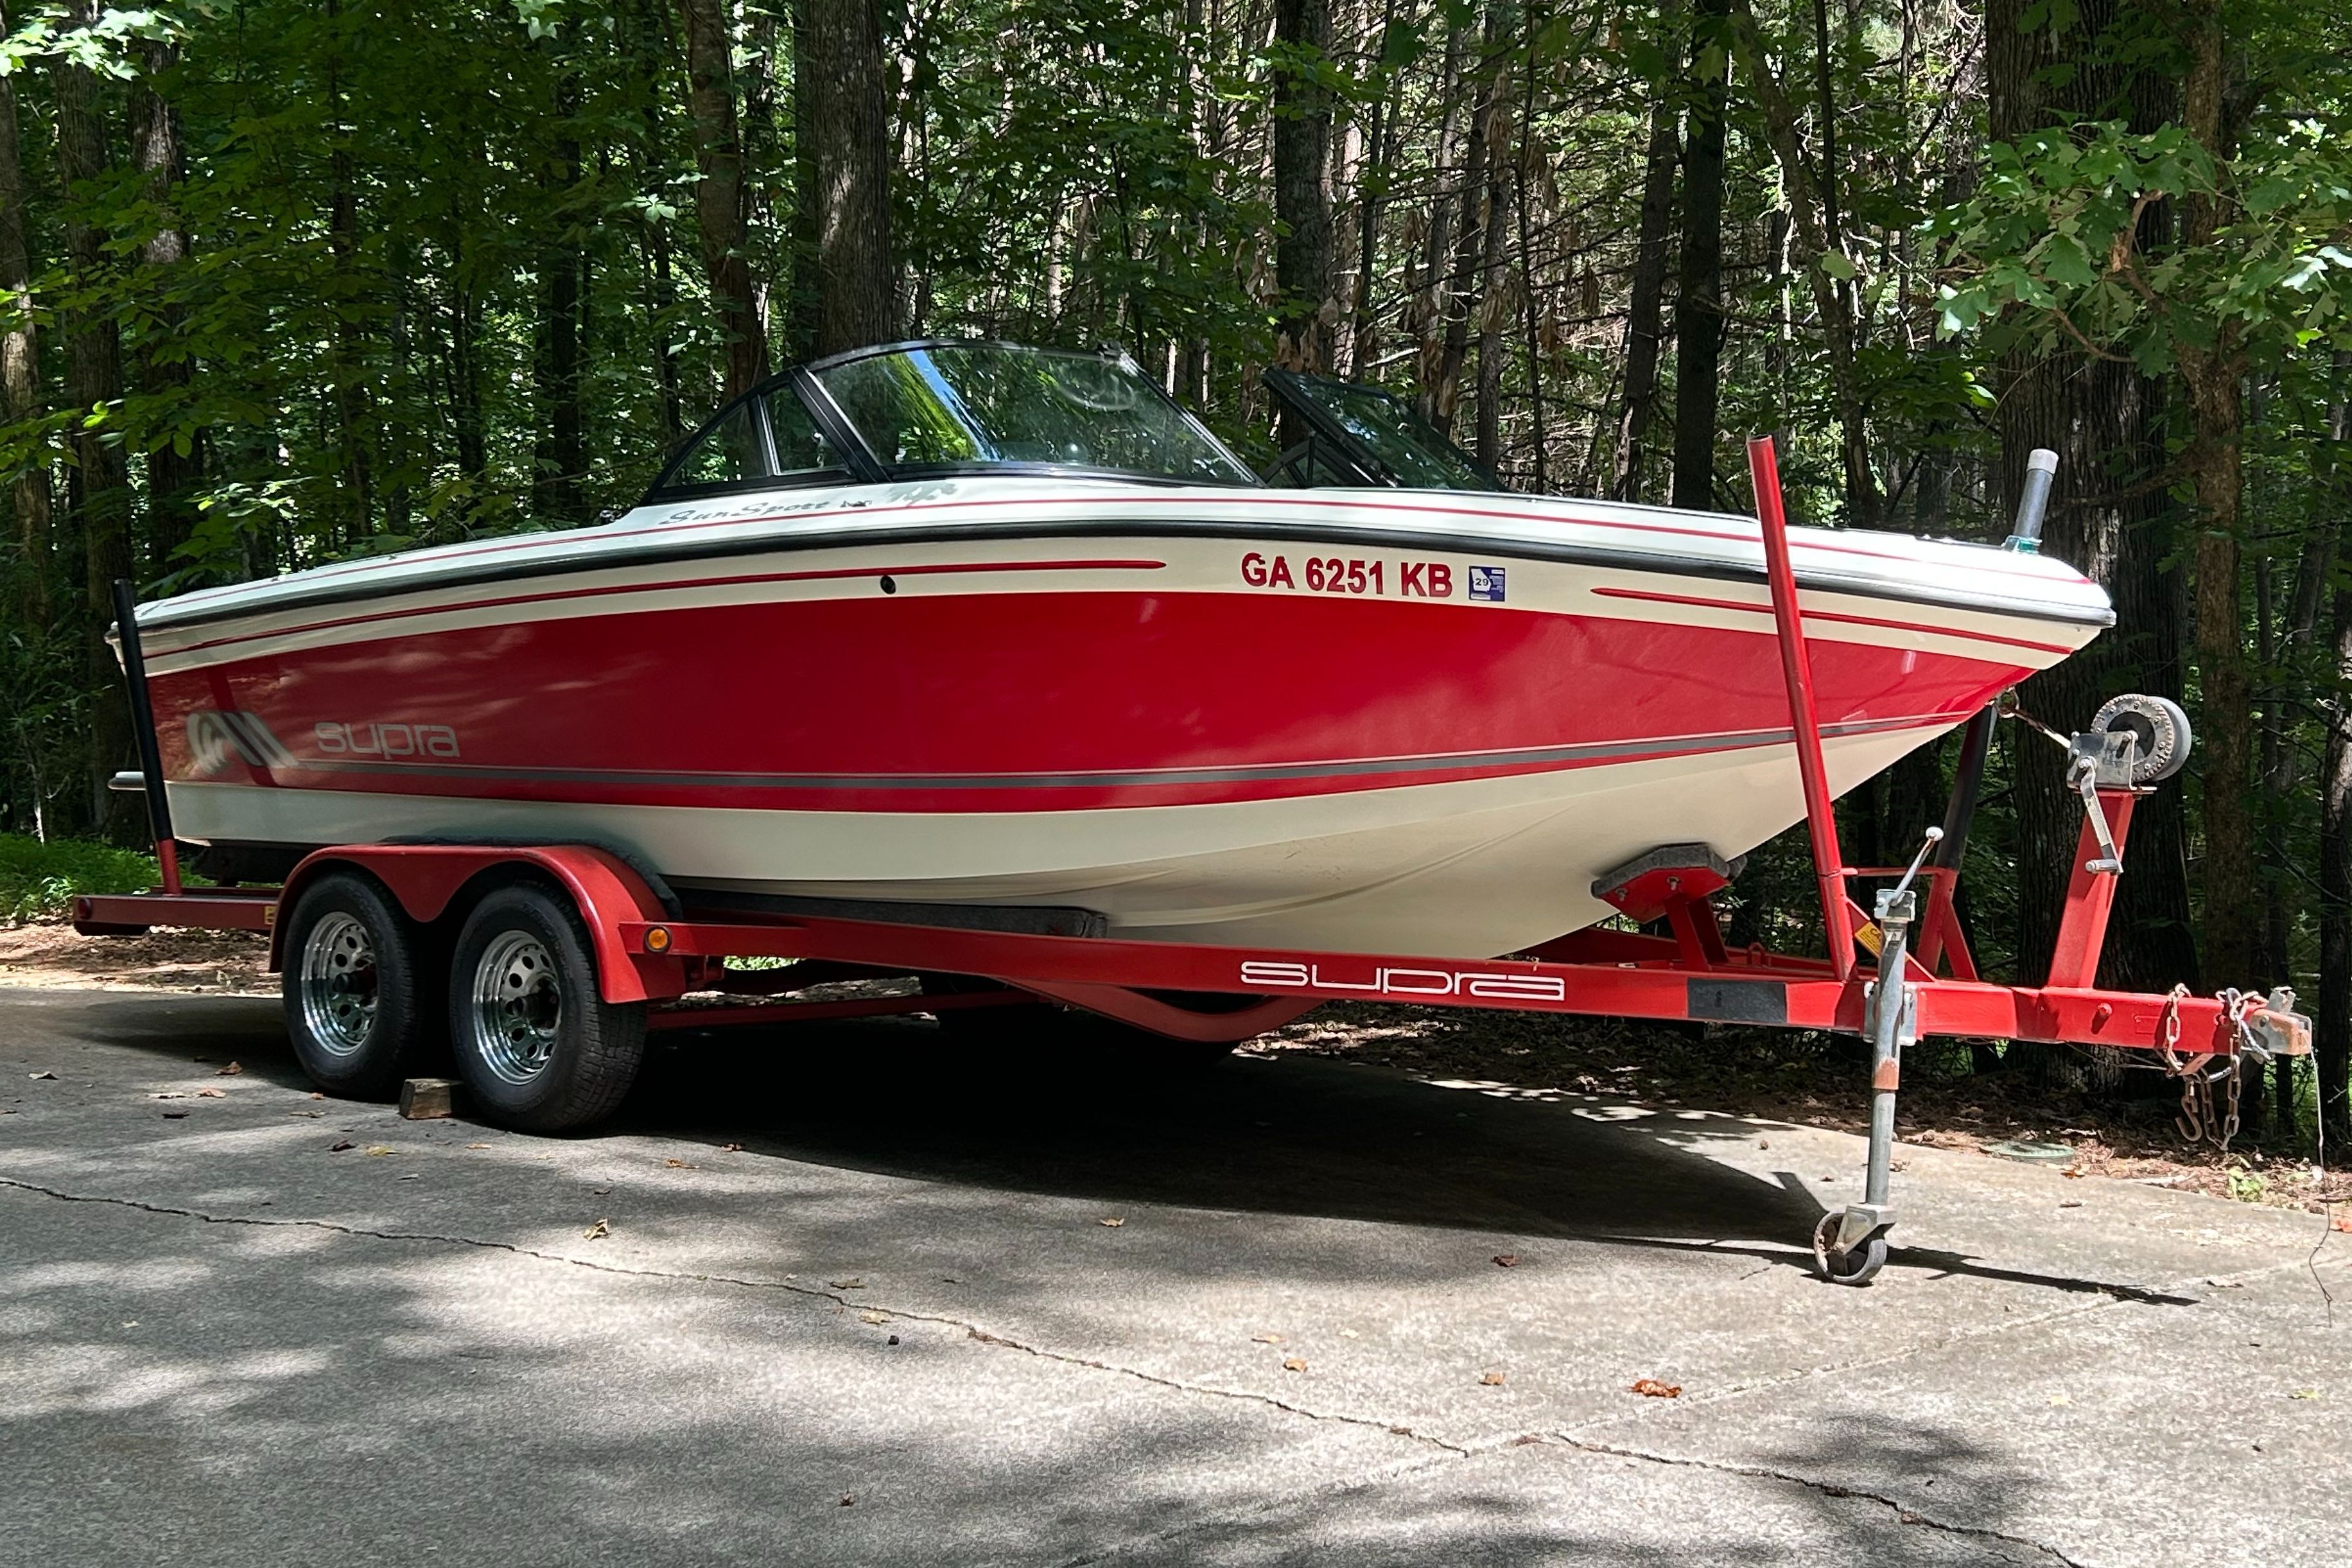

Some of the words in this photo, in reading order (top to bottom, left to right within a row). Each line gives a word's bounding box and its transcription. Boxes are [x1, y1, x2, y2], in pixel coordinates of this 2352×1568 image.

[1241, 552, 1295, 589] GA
[1305, 557, 1384, 595] 6251
[1400, 562, 1452, 598] KB
[1475, 577, 1489, 586] 29
[314, 722, 460, 760] supra
[1241, 961, 1565, 1002] supra
